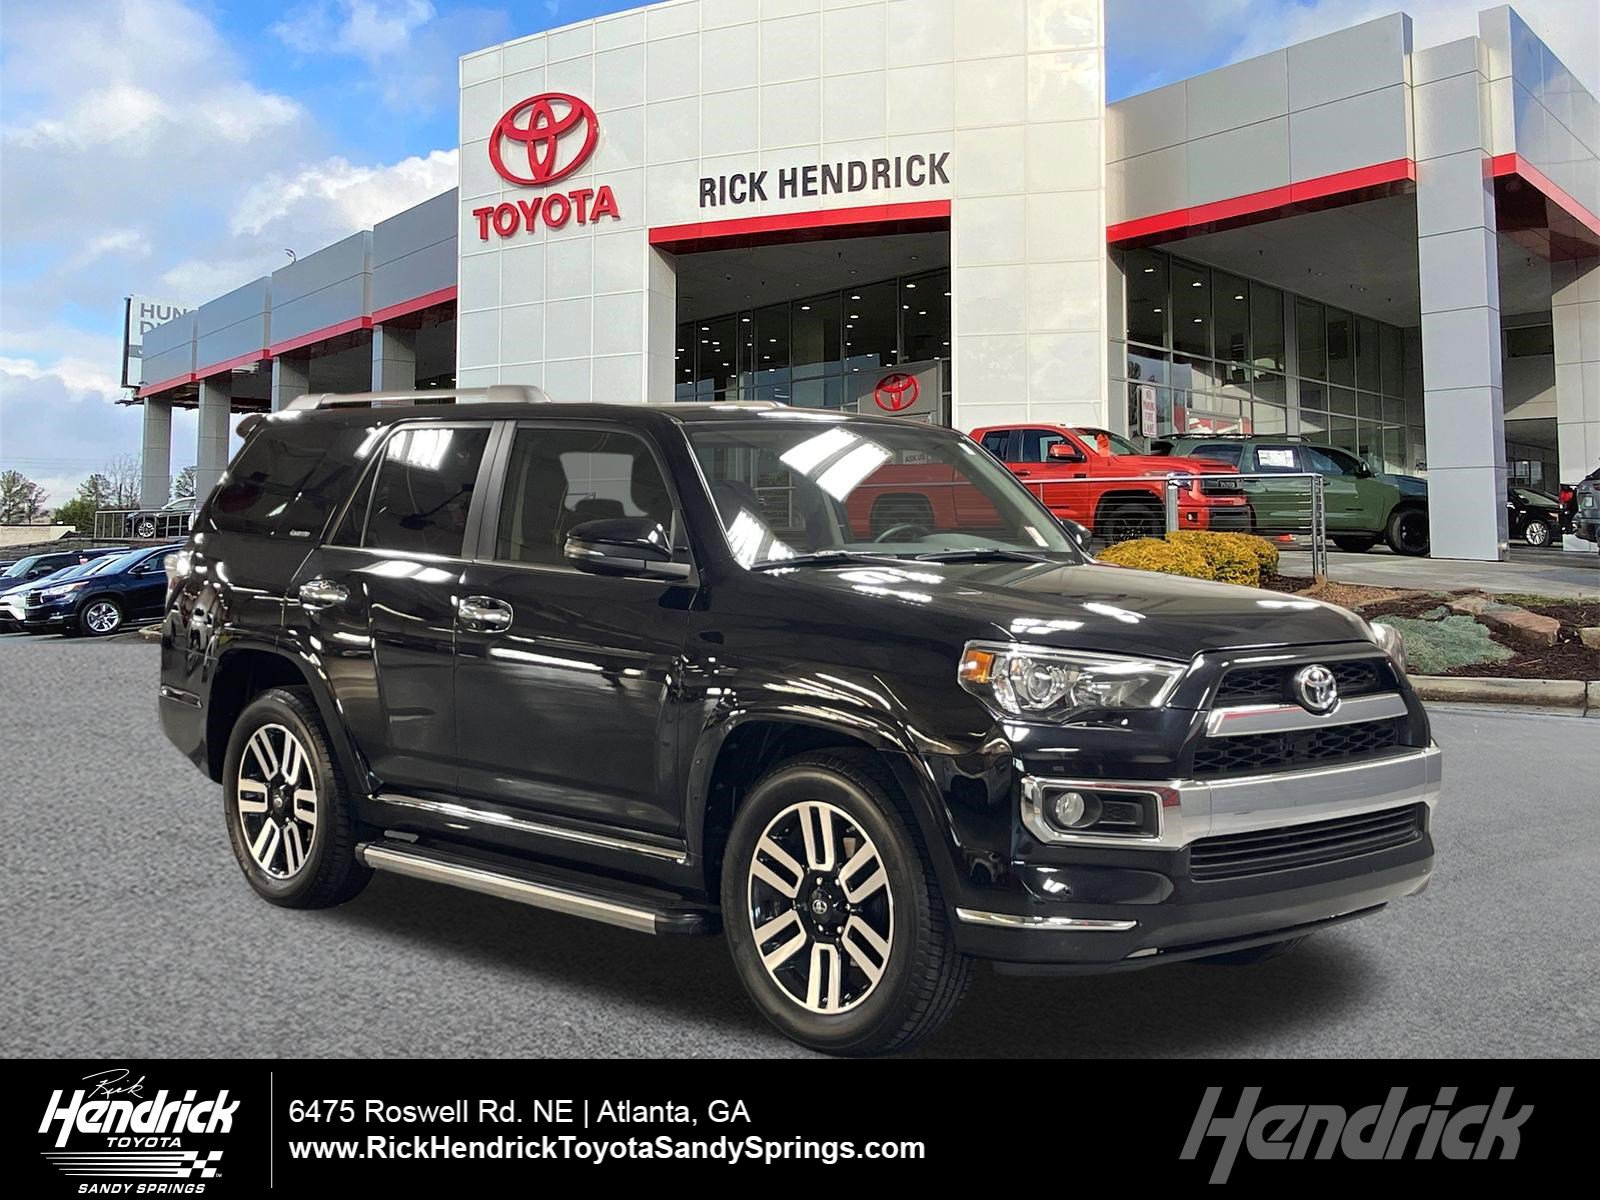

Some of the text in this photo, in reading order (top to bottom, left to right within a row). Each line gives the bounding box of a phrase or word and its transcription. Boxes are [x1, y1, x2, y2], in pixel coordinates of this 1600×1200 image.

[698, 151, 951, 208] RICK HENDRICK
[472, 184, 621, 241] TOYOTA
